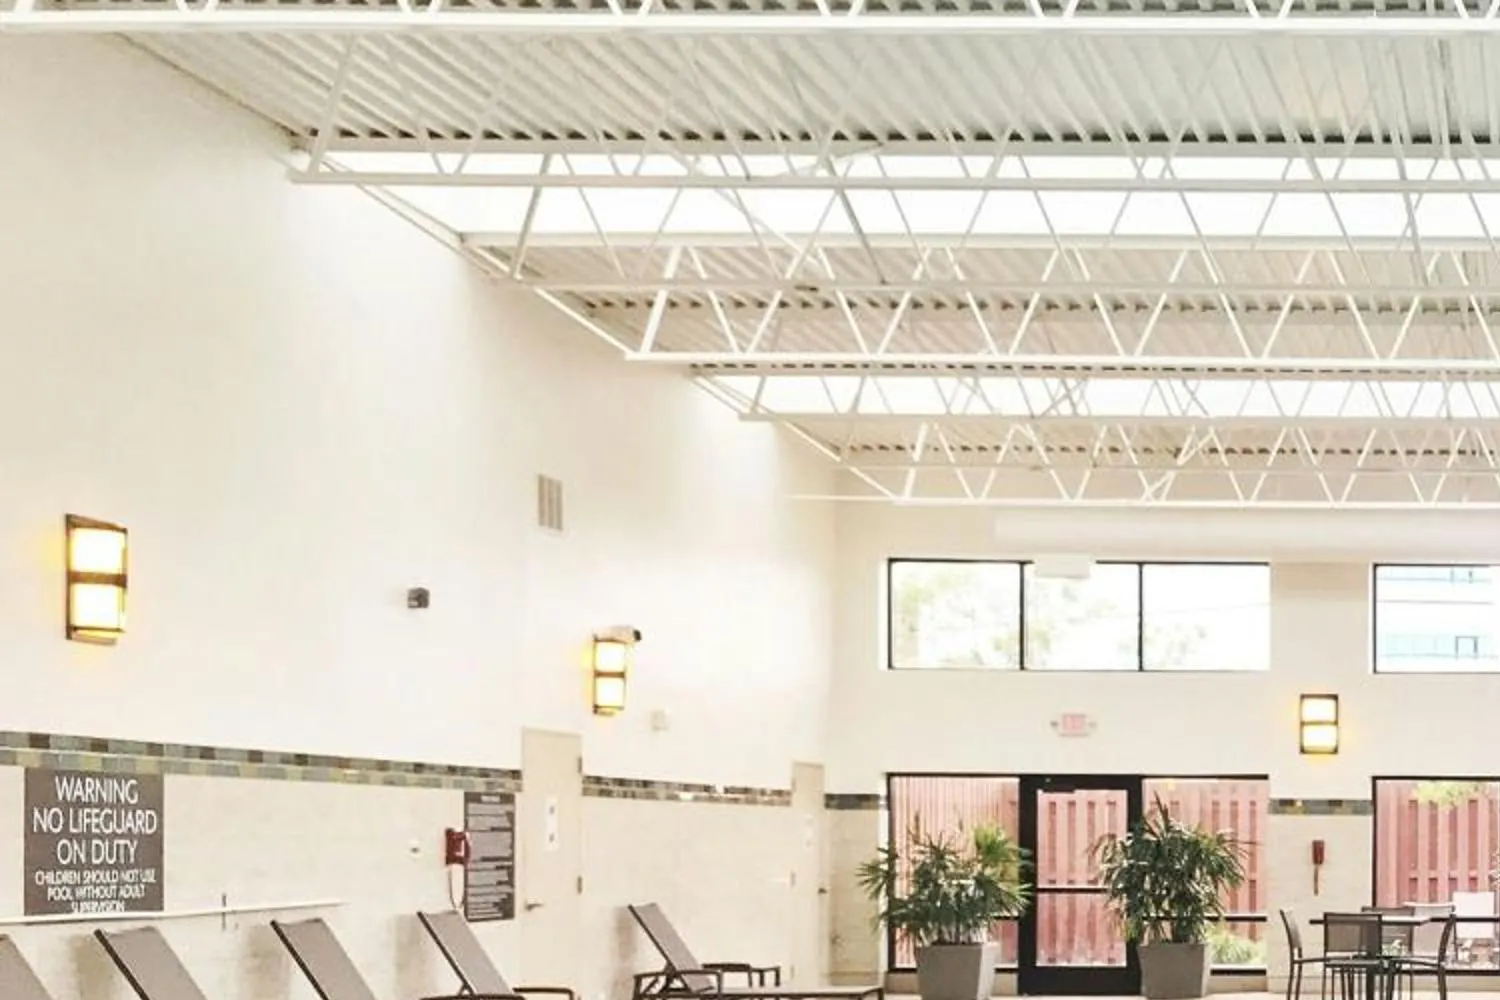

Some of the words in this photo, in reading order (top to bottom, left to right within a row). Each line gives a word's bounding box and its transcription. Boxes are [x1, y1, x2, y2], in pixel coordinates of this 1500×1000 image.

[55, 776, 139, 804] WARNING
[33, 807, 64, 833] NO
[69, 808, 157, 834] LIFEGUARD
[57, 839, 87, 864] ON
[91, 839, 138, 864] DUTY
[35, 869, 81, 885] CHILDREN
[82, 869, 119, 884] SHOULD
[47, 885, 74, 900] POOL
[75, 885, 117, 899] WITHOUT
